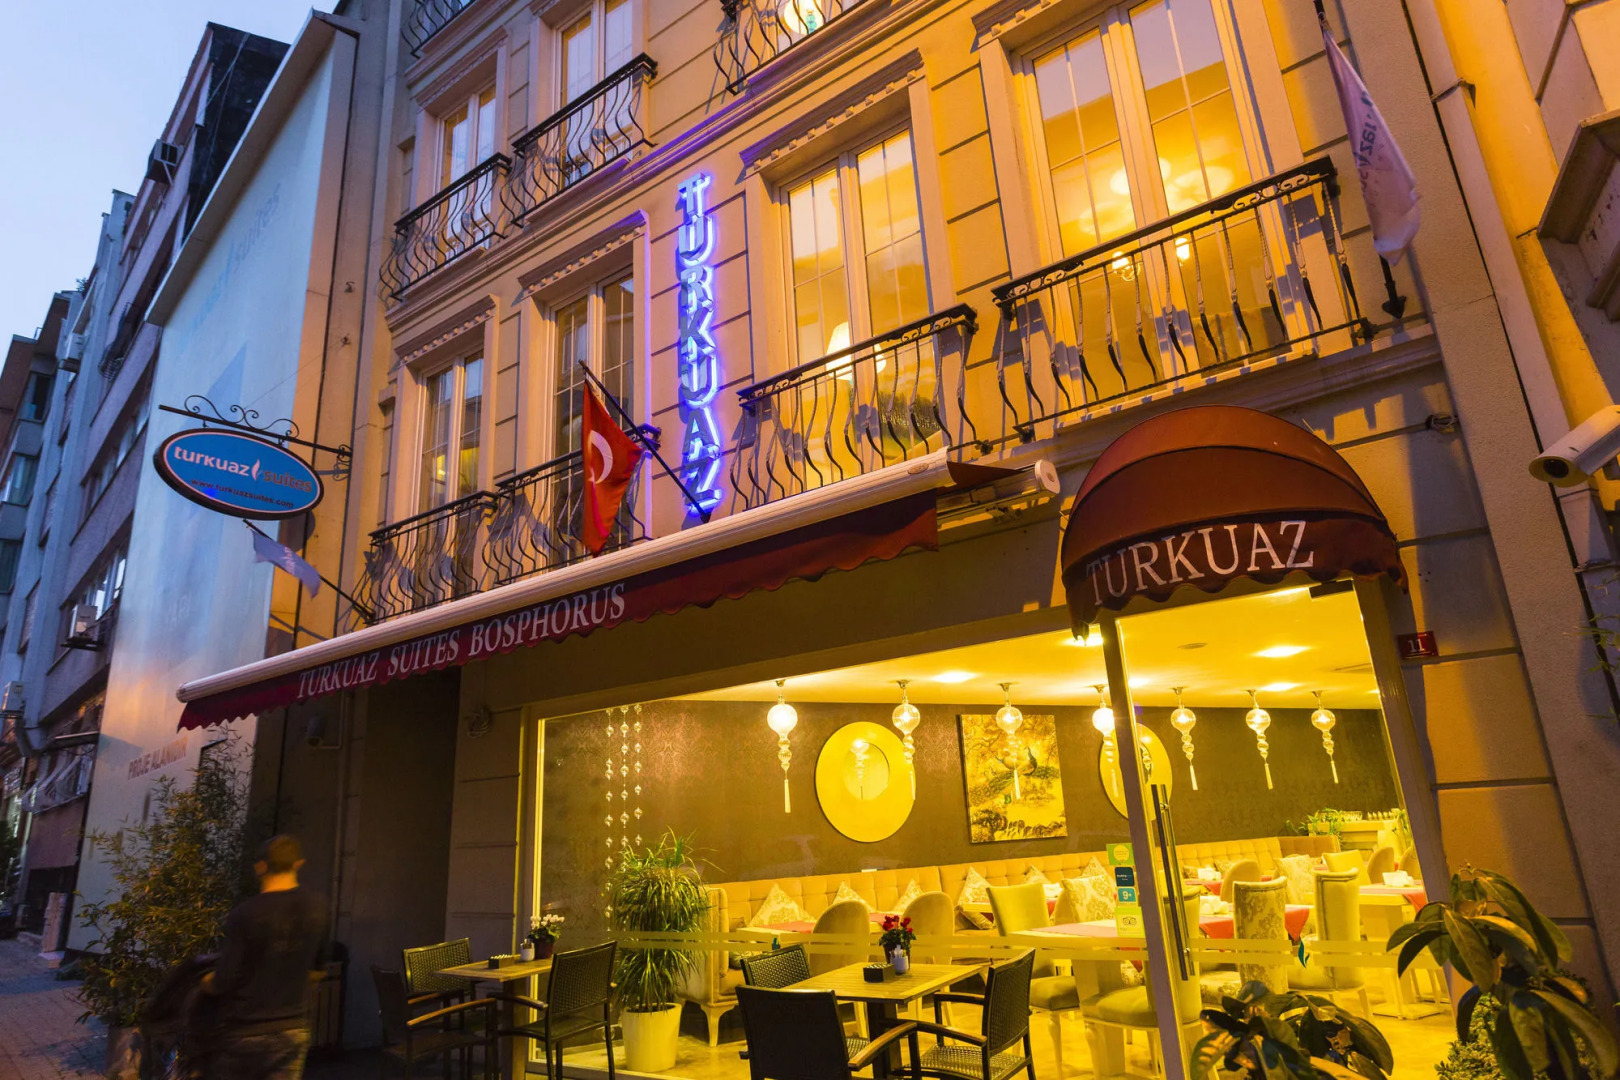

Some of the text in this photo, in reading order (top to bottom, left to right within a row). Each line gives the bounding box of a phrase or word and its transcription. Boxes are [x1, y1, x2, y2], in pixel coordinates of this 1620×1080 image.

[677, 172, 722, 513] TURKUAZ
[174, 446, 313, 493] turkuaz suites
[190, 478, 295, 509] www.turkuazsuites.com
[1086, 520, 1314, 606] TURKUAZ
[297, 582, 626, 699] TURKUAZ SUITES BOSPHORUS
[1408, 638, 1425, 652] 11
